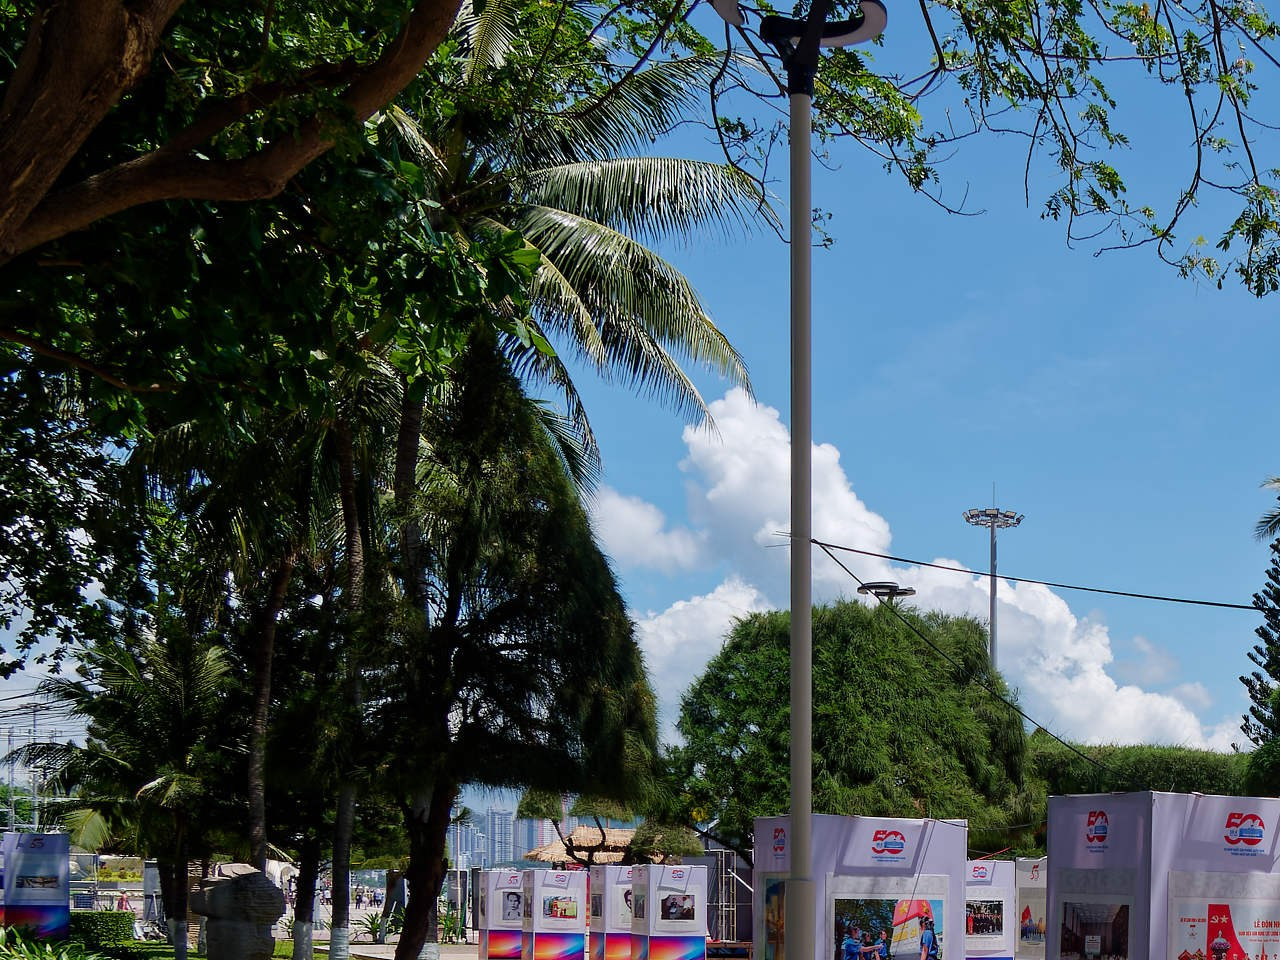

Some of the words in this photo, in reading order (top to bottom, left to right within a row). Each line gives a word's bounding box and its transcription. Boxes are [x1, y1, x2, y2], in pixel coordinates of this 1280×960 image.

[1087, 811, 1108, 842] 50
[1224, 812, 1265, 845] 50
[872, 830, 905, 854] 50
[972, 866, 987, 878] 50
